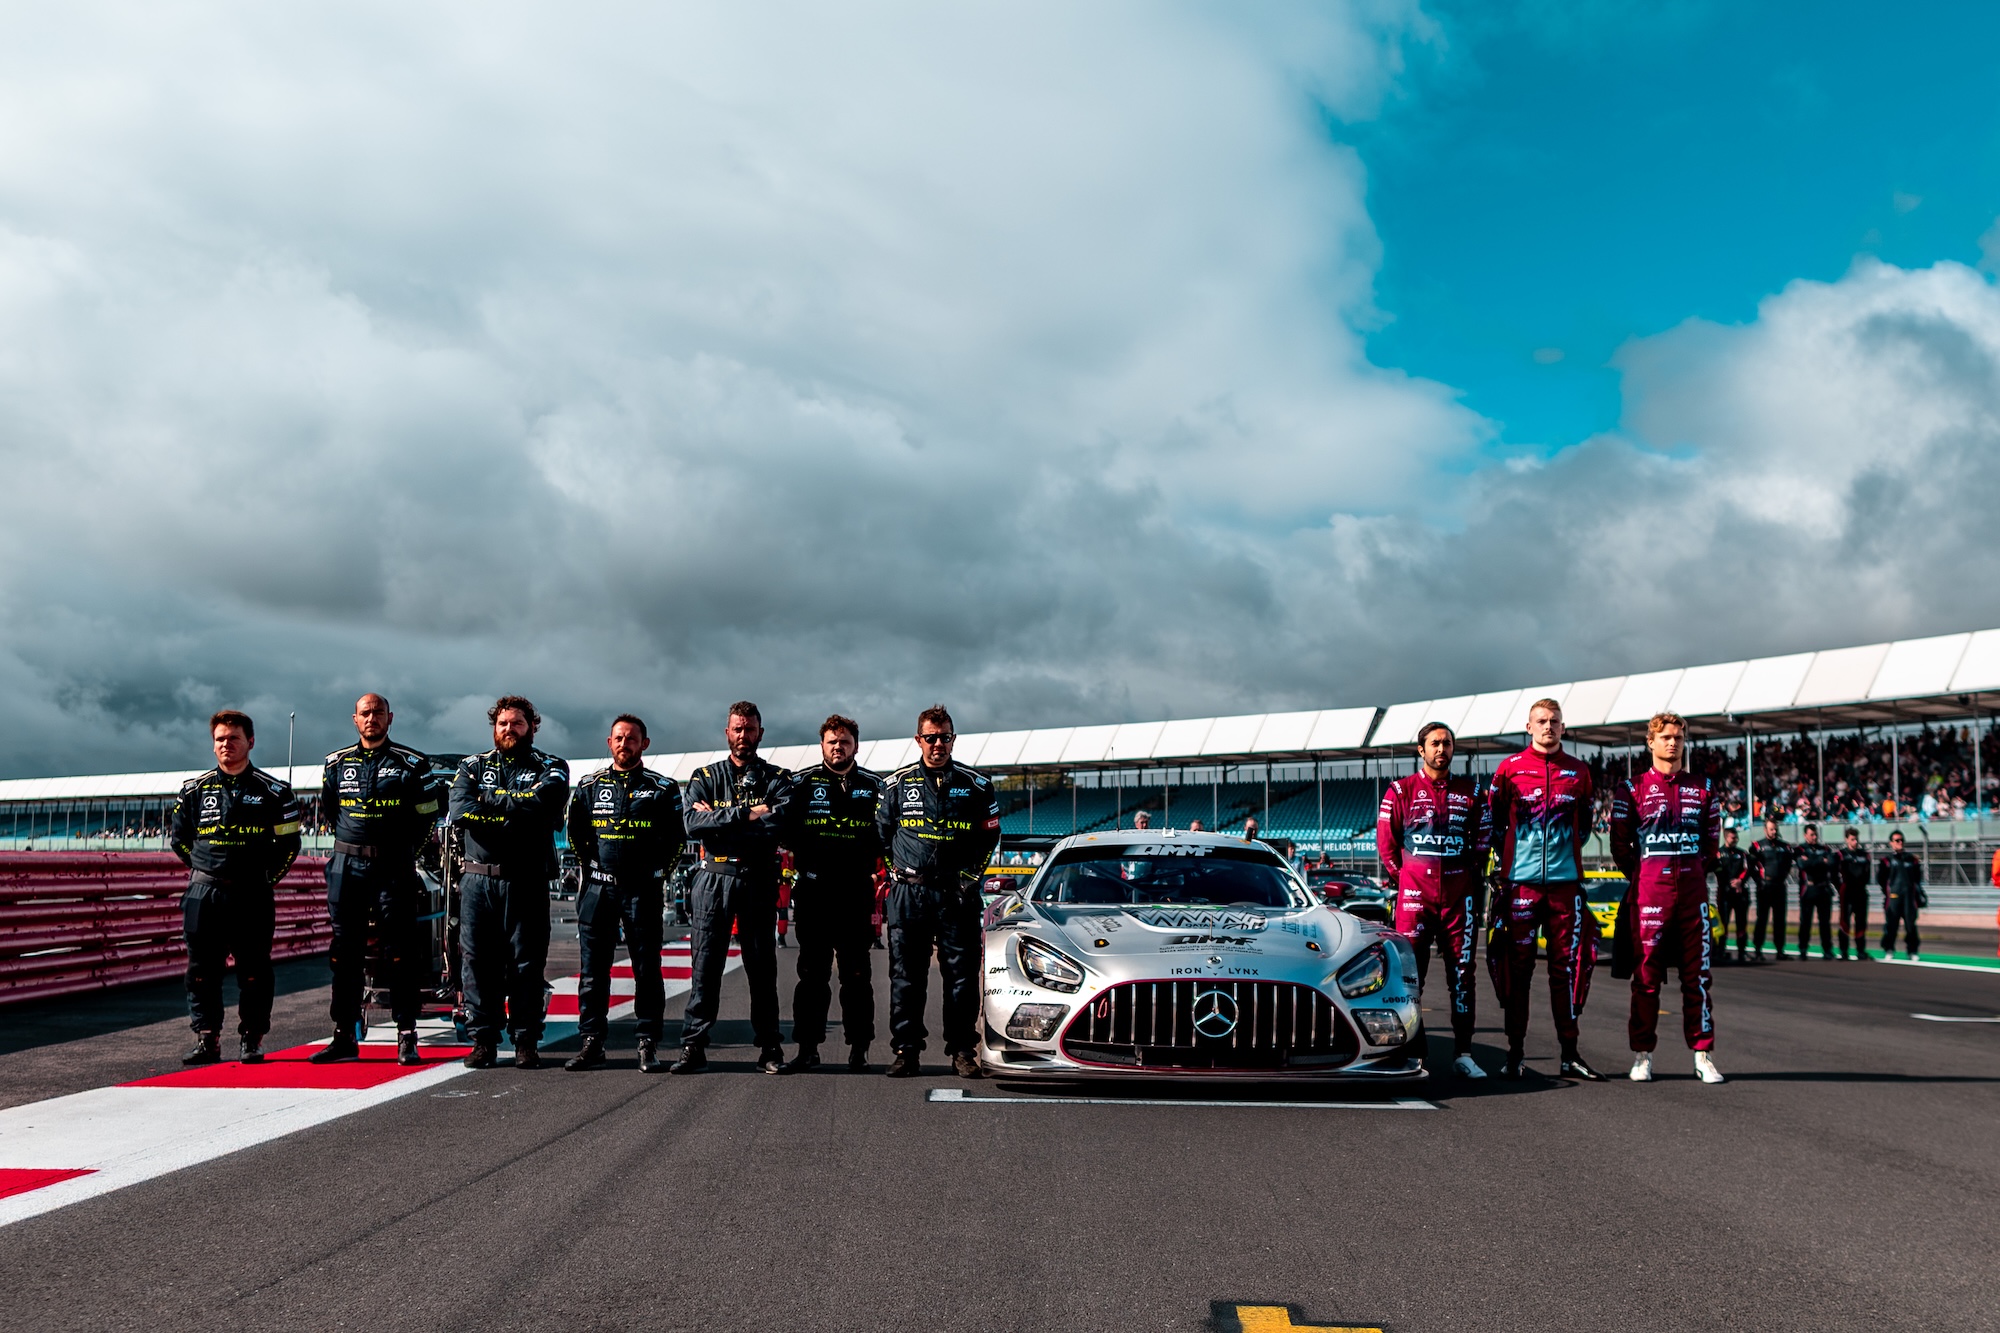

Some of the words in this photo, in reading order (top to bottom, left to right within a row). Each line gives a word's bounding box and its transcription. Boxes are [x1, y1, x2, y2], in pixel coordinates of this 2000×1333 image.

[376, 799, 400, 807] LYNX
[628, 820, 652, 828] LYNX
[900, 819, 925, 828] IRON
[947, 820, 972, 830] LYNX
[1412, 833, 1464, 845] QATAR
[1646, 832, 1700, 844] QATAR
[1136, 844, 1216, 857] QMMF
[1324, 842, 1377, 852] HELICOPTERS
[1460, 896, 1474, 964] QATAR
[1174, 935, 1258, 946] QMMF
[1700, 902, 1711, 971] QATAR
[1171, 967, 1202, 975] IRON
[1228, 967, 1260, 976] LYNX
